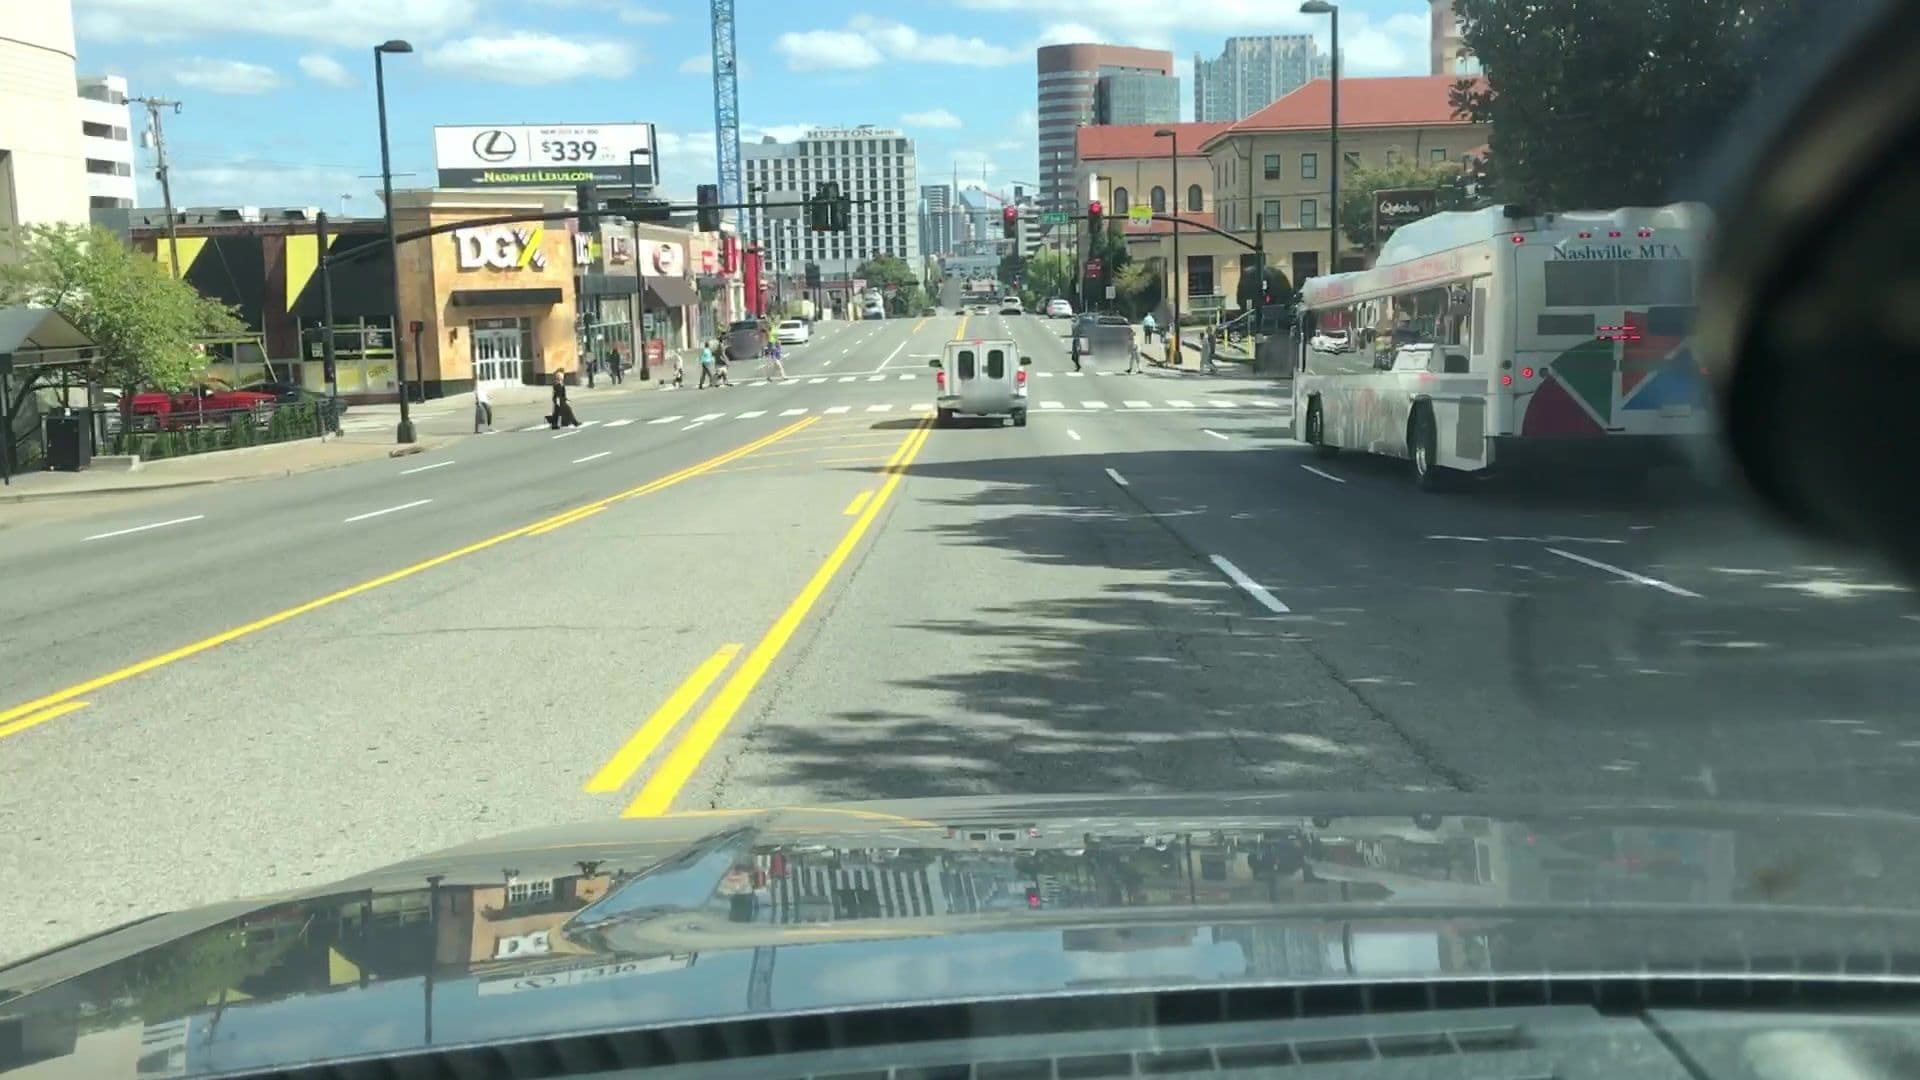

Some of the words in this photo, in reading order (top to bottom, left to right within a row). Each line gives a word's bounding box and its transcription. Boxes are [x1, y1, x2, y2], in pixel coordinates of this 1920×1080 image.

[807, 128, 873, 138] HUTTON
[542, 140, 597, 161] $339
[455, 227, 545, 267] DGX
[1553, 245, 1632, 259] Nashville
[1639, 244, 1685, 258] MTA
